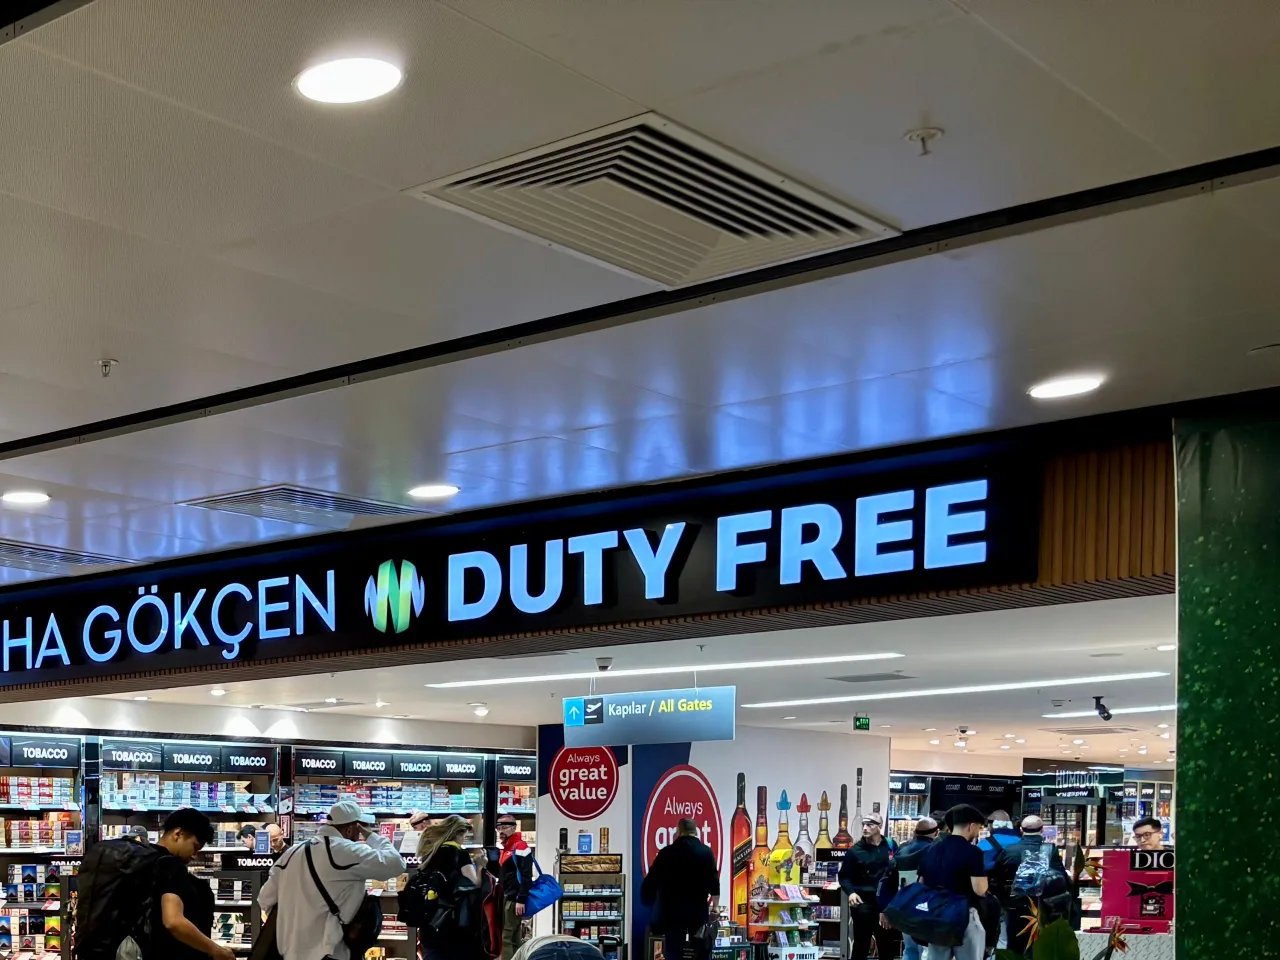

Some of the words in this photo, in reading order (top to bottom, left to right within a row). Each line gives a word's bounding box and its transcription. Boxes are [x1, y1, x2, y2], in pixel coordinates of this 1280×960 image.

[447, 521, 687, 622] DUTY
[716, 479, 988, 592] FREE
[82, 570, 336, 660] GÖKÇEN
[608, 701, 647, 718] Kapılar
[658, 699, 674, 713] All
[677, 698, 713, 712] Gates
[23, 747, 68, 760] TOBACCO
[111, 750, 153, 763] TOBACCO
[173, 753, 213, 765] TOBACCO
[567, 753, 600, 765] Always
[229, 755, 267, 767] TOBACCO
[301, 758, 336, 769] TOBACCO
[352, 760, 386, 771] TOBACCO
[400, 762, 431, 773] TOBACCO
[446, 763, 476, 773] TOBACCO
[503, 765, 531, 775] TOBACCO
[559, 764, 608, 786] great
[1055, 769, 1100, 789] HUMIDOR
[559, 783, 608, 801] value
[664, 797, 703, 819] Always
[655, 820, 712, 850] grt
[237, 858, 273, 867] TOBACCO
